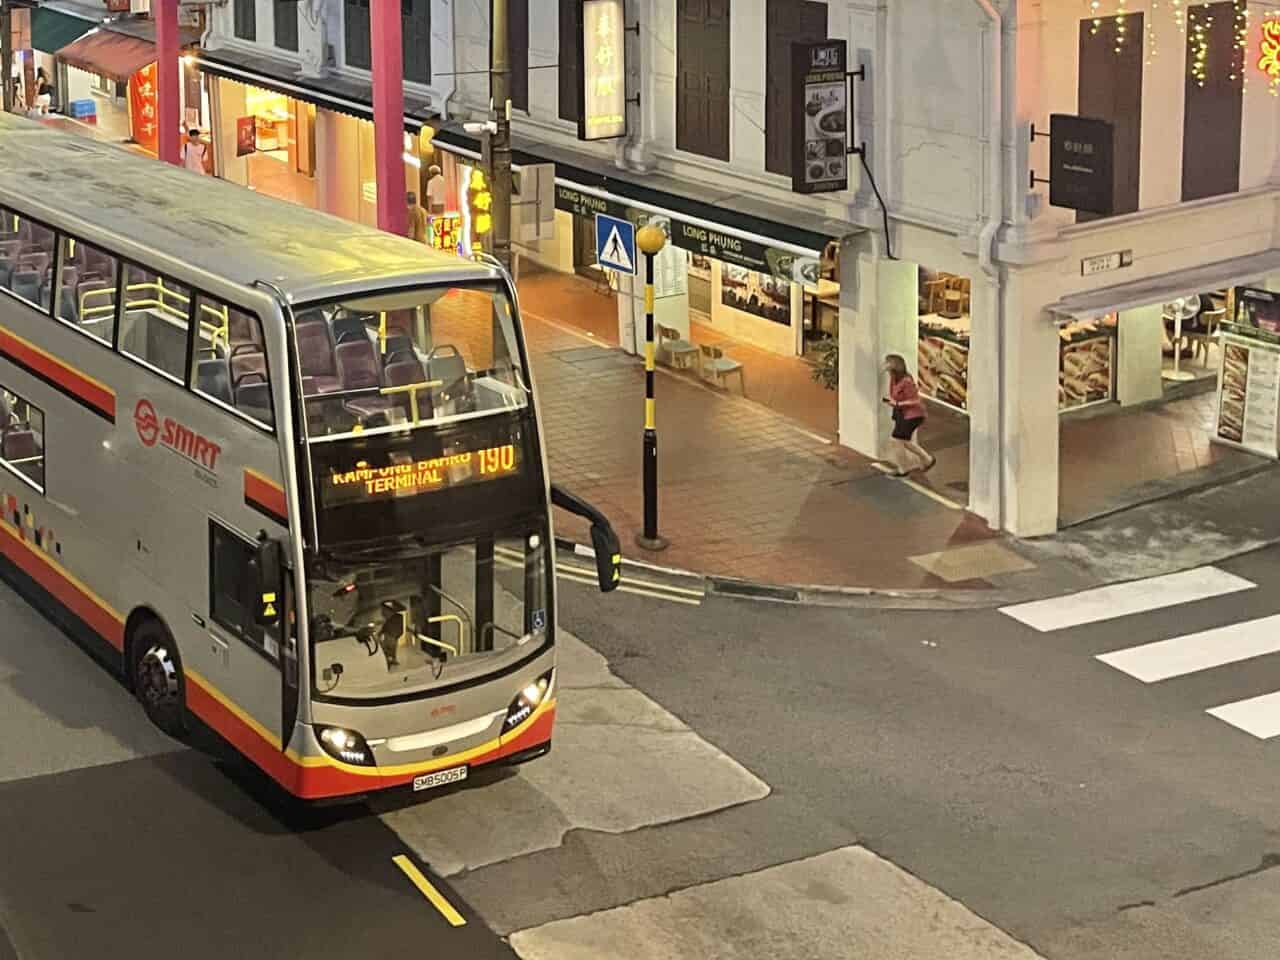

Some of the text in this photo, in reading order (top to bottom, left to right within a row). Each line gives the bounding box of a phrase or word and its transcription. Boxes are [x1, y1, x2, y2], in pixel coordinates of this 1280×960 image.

[560, 189, 580, 203] LONG
[683, 224, 707, 241] LONG
[478, 444, 515, 474] 190
[365, 469, 443, 494] TERMINAL
